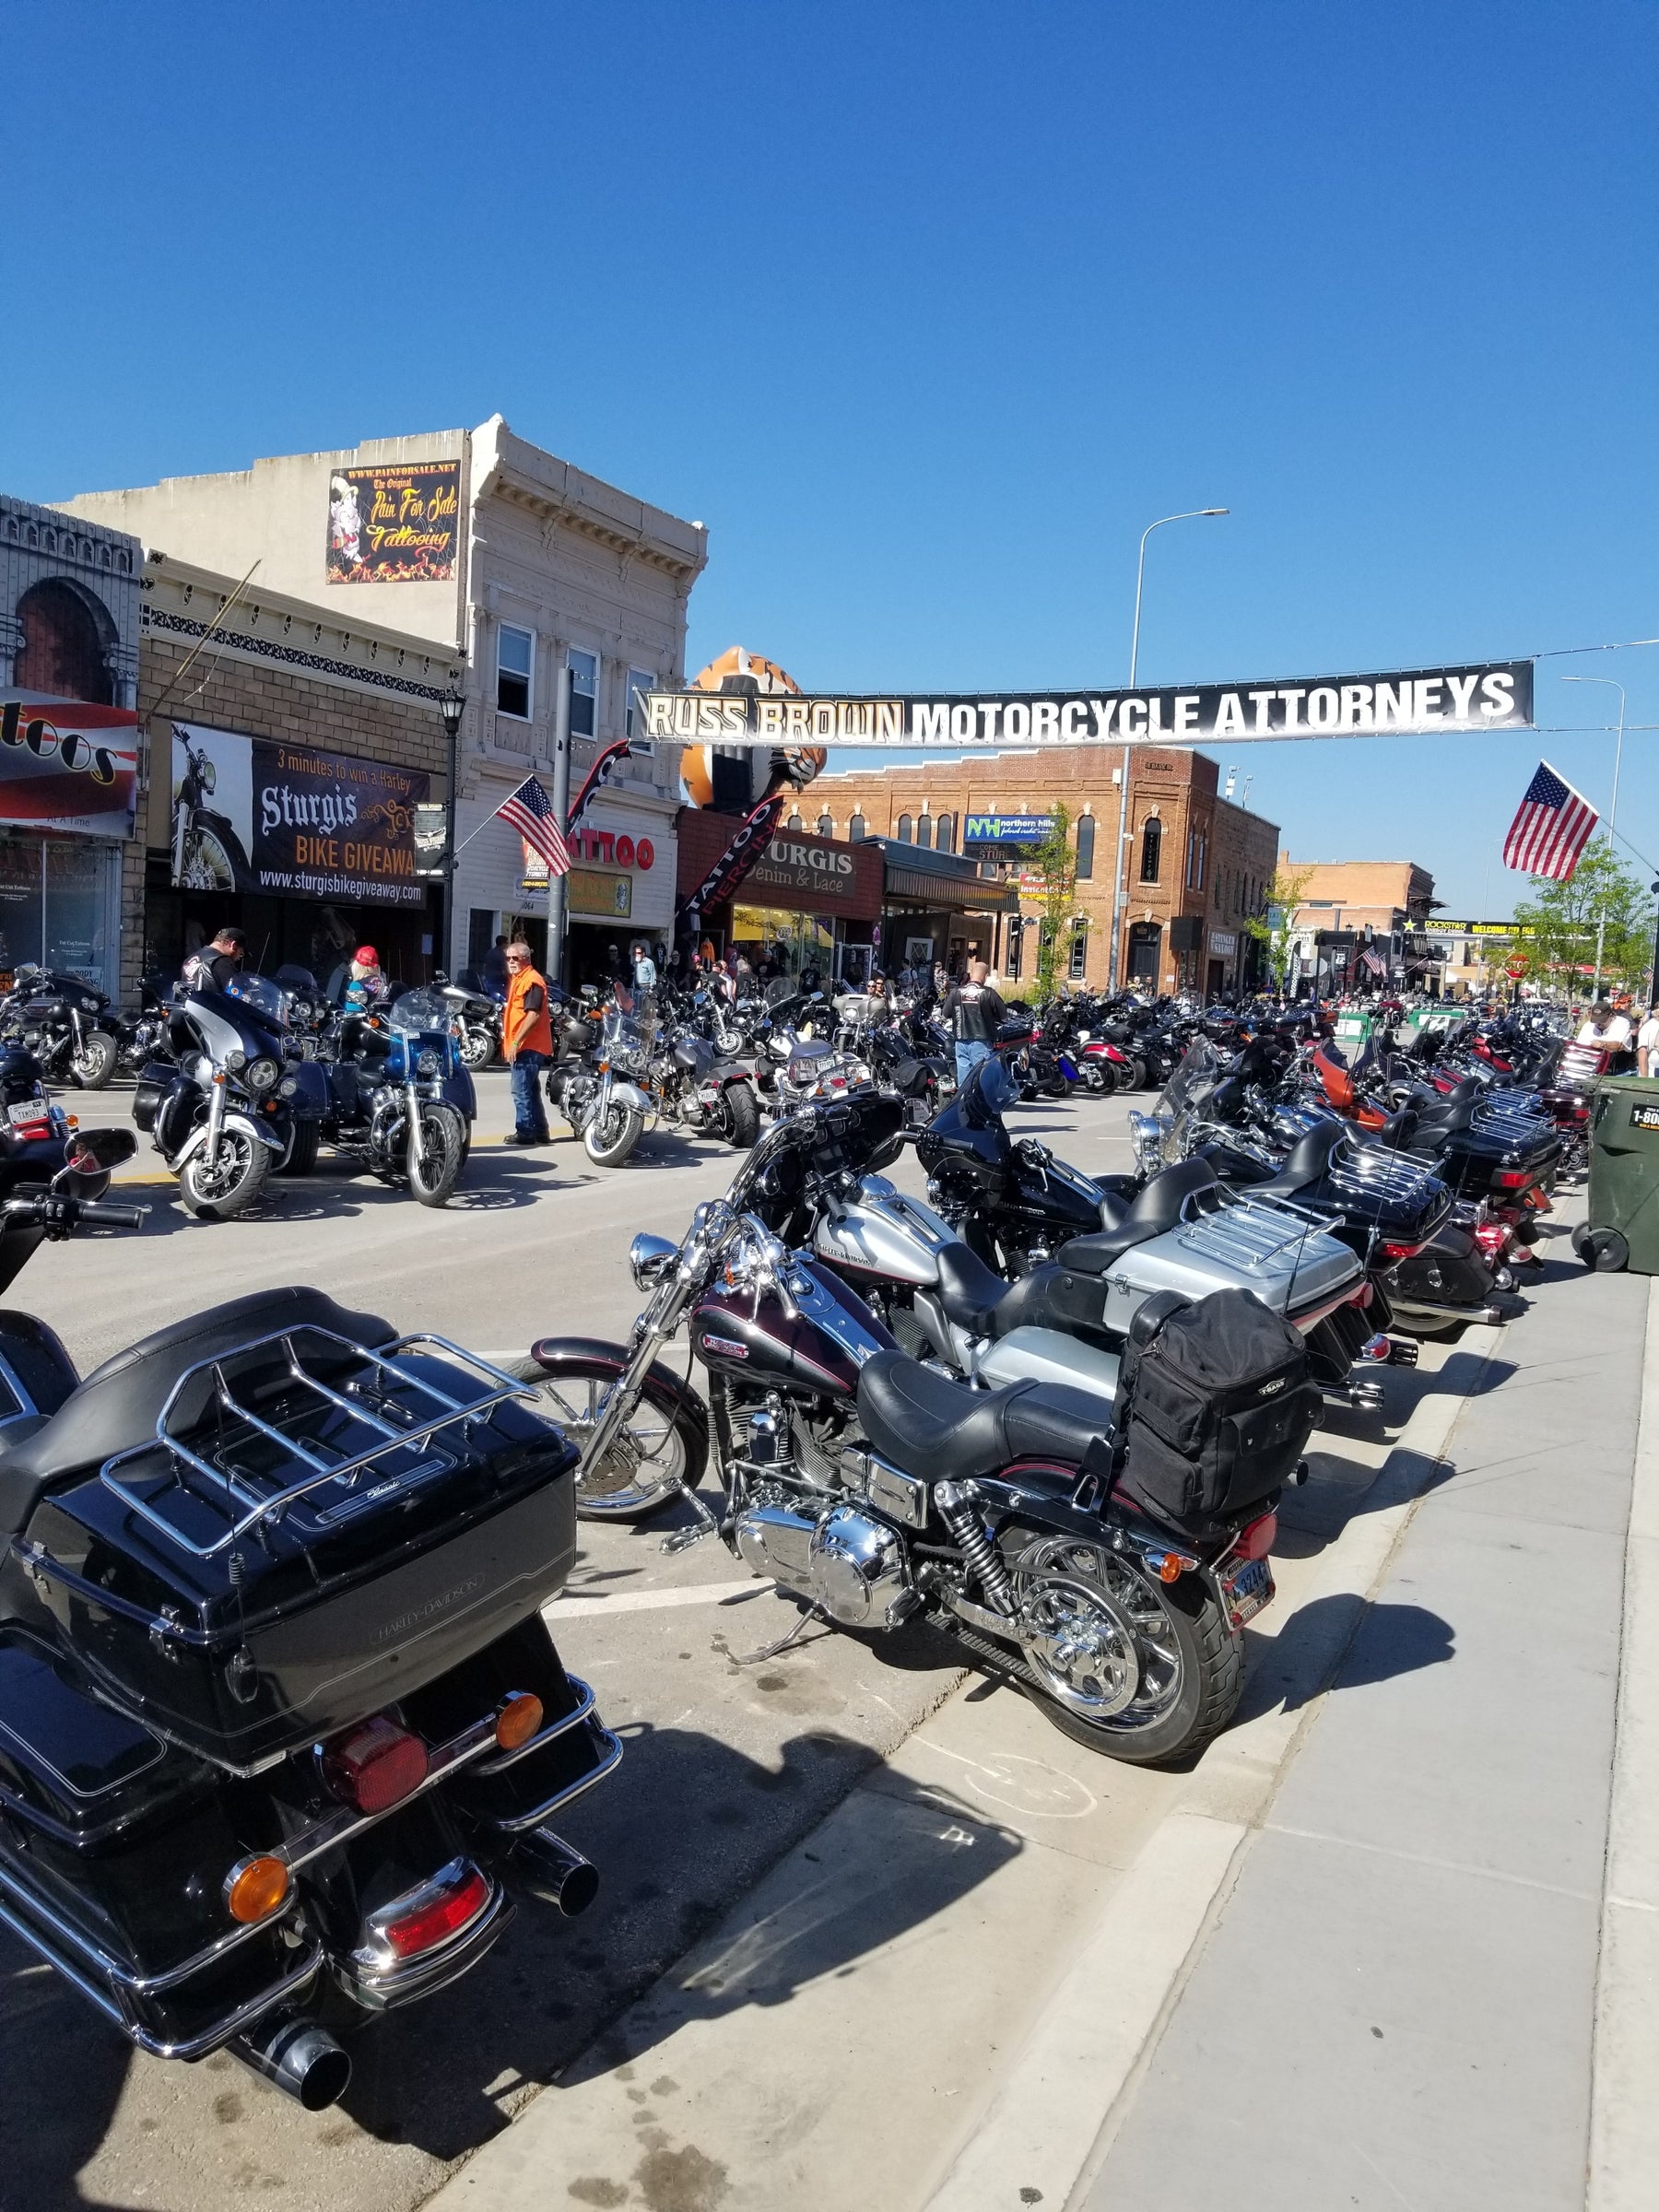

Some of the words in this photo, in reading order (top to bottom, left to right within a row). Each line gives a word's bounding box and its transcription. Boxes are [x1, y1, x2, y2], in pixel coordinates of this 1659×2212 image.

[348, 464, 456, 478] WWW.PAINFORSALE.NET
[372, 479, 386, 489] The
[387, 477, 413, 489] Original
[371, 490, 396, 524] Pain
[399, 488, 425, 523] For
[427, 485, 457, 522] Sale
[366, 524, 451, 558] Tattooing
[647, 694, 747, 739] RUSS
[756, 698, 904, 745] BROWN
[912, 695, 1200, 741] MOTORCYCLE
[1212, 672, 1515, 735] ATTORNEYS
[0, 701, 117, 784] toos
[277, 749, 285, 768] 3
[288, 754, 333, 776] minutes
[335, 762, 346, 780] to
[349, 766, 368, 784] win
[371, 771, 377, 784] a
[380, 769, 411, 795] Harley
[261, 783, 358, 837] Sturgis
[1000, 819, 1036, 828] northern
[1038, 819, 1055, 828] hills
[296, 835, 338, 867] BIKE
[344, 841, 415, 875] GIVEAWA
[565, 828, 654, 870] ATTOO
[686, 804, 771, 912] TATTOO
[760, 841, 853, 875] URGIS
[260, 870, 421, 902] www.sturgisbikegiveaway.com
[796, 867, 809, 887] &
[814, 871, 843, 892] Lace
[1424, 920, 1466, 931] ROCKSTAR
[1472, 924, 1507, 935] WELCOME
[1633, 1110, 1659, 1125] 1-80
[367, 1480, 400, 1499] Classic
[378, 1577, 478, 1640] HARLEY-DAVIDSON
